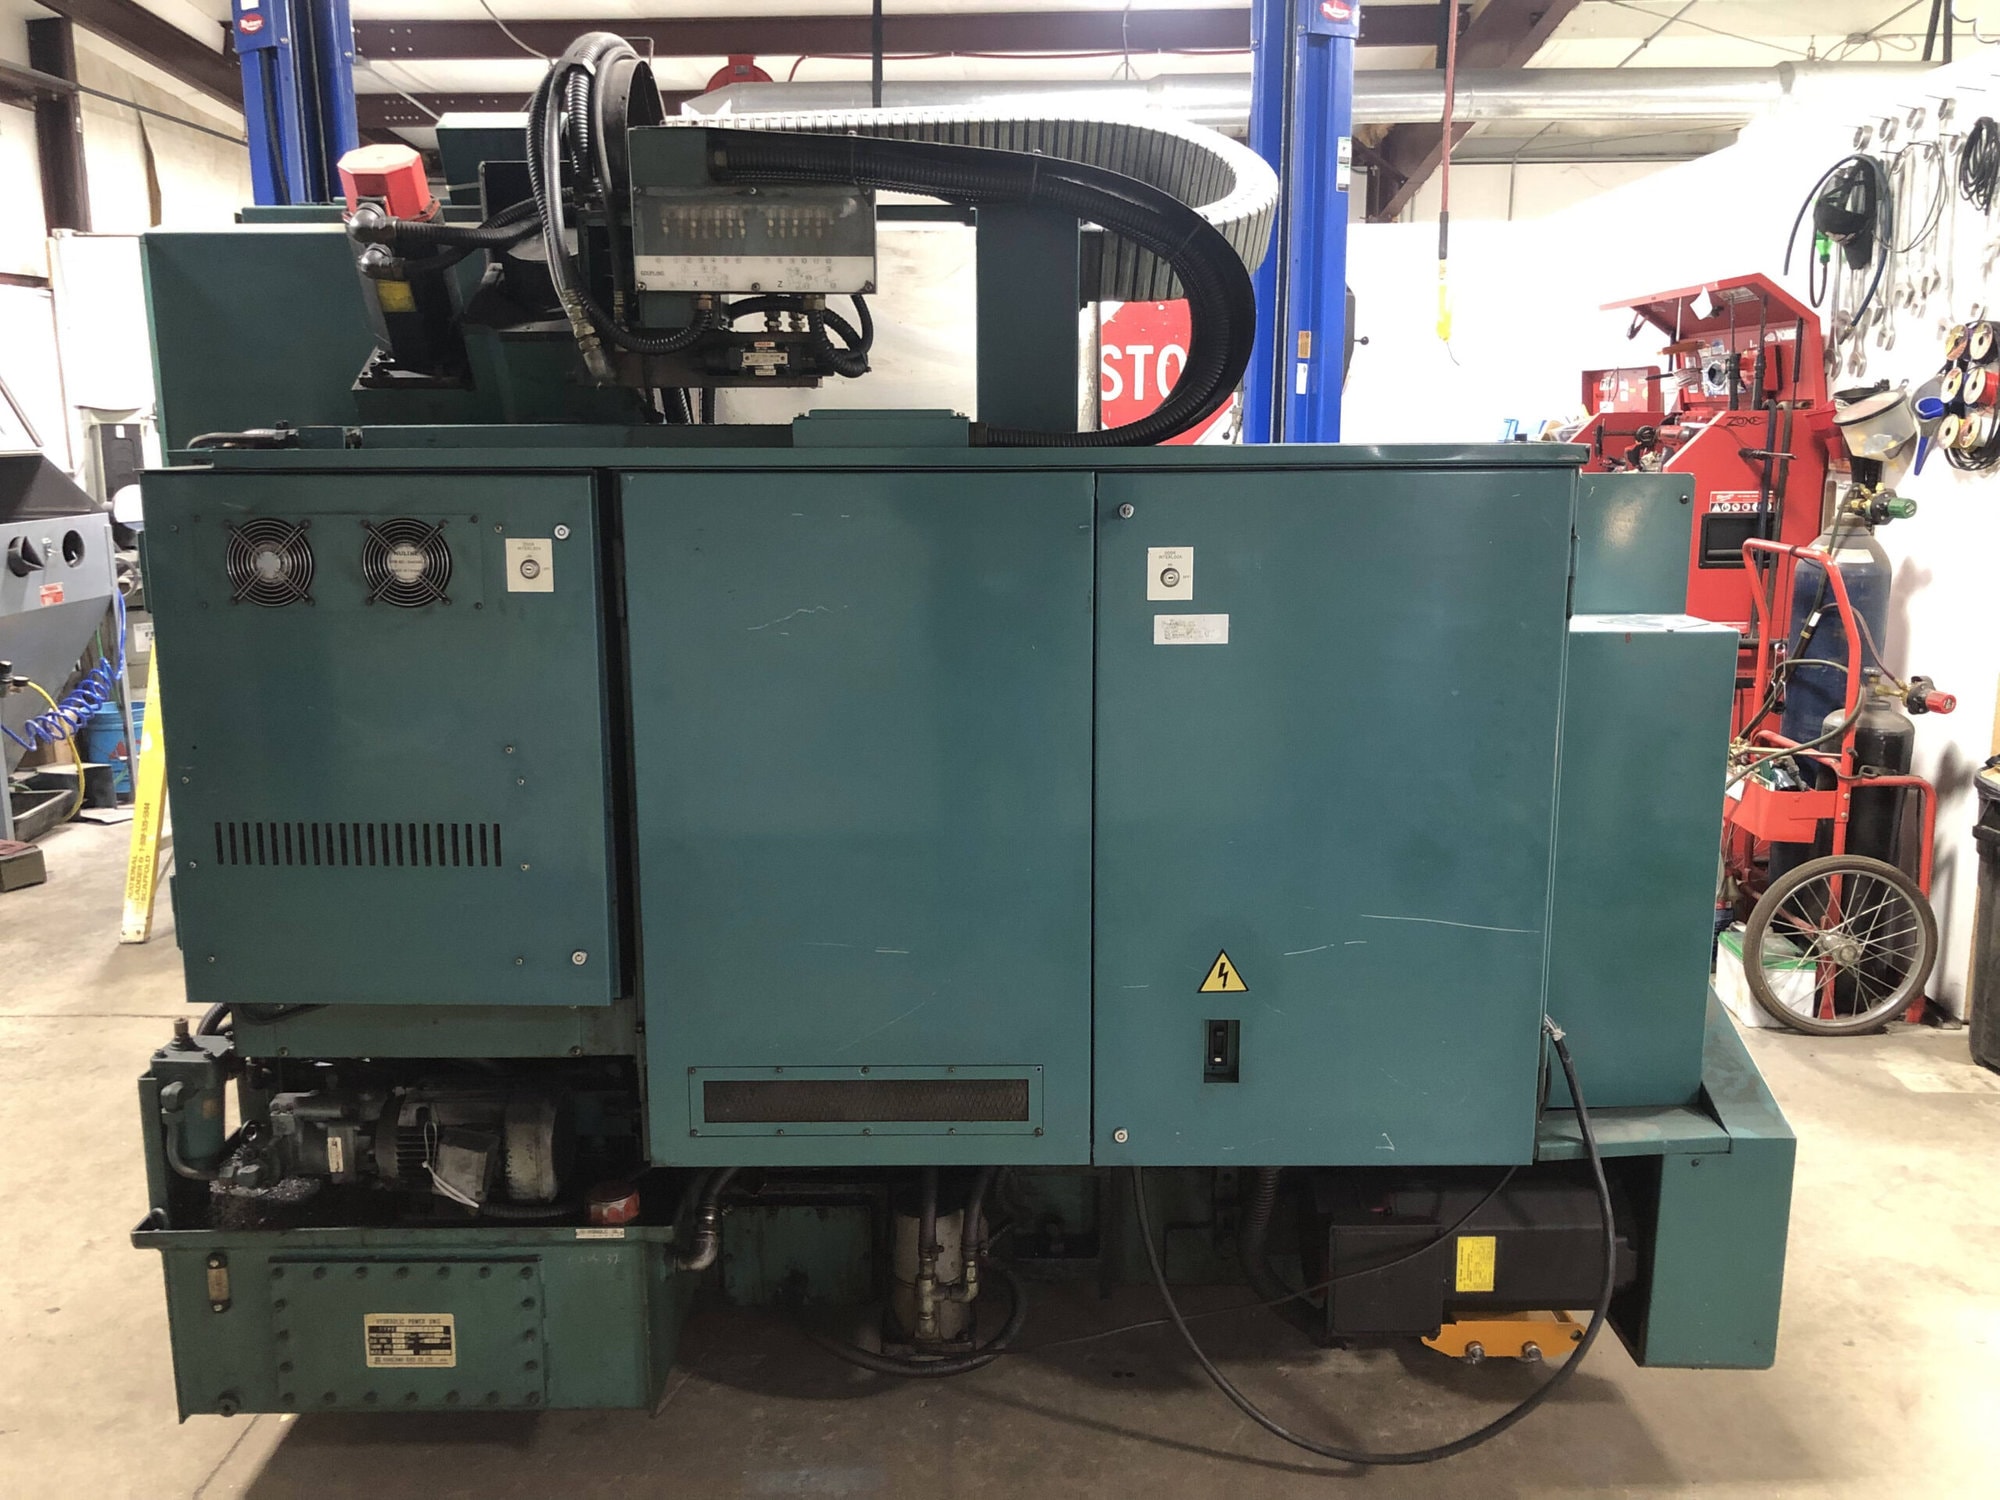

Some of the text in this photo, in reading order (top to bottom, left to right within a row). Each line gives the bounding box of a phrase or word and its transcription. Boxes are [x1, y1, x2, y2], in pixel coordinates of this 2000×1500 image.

[1101, 344, 1188, 401] STO
[127, 855, 138, 900] NATIONAL
[134, 865, 143, 901] LADDER
[141, 855, 150, 902] SCAFFOLD
